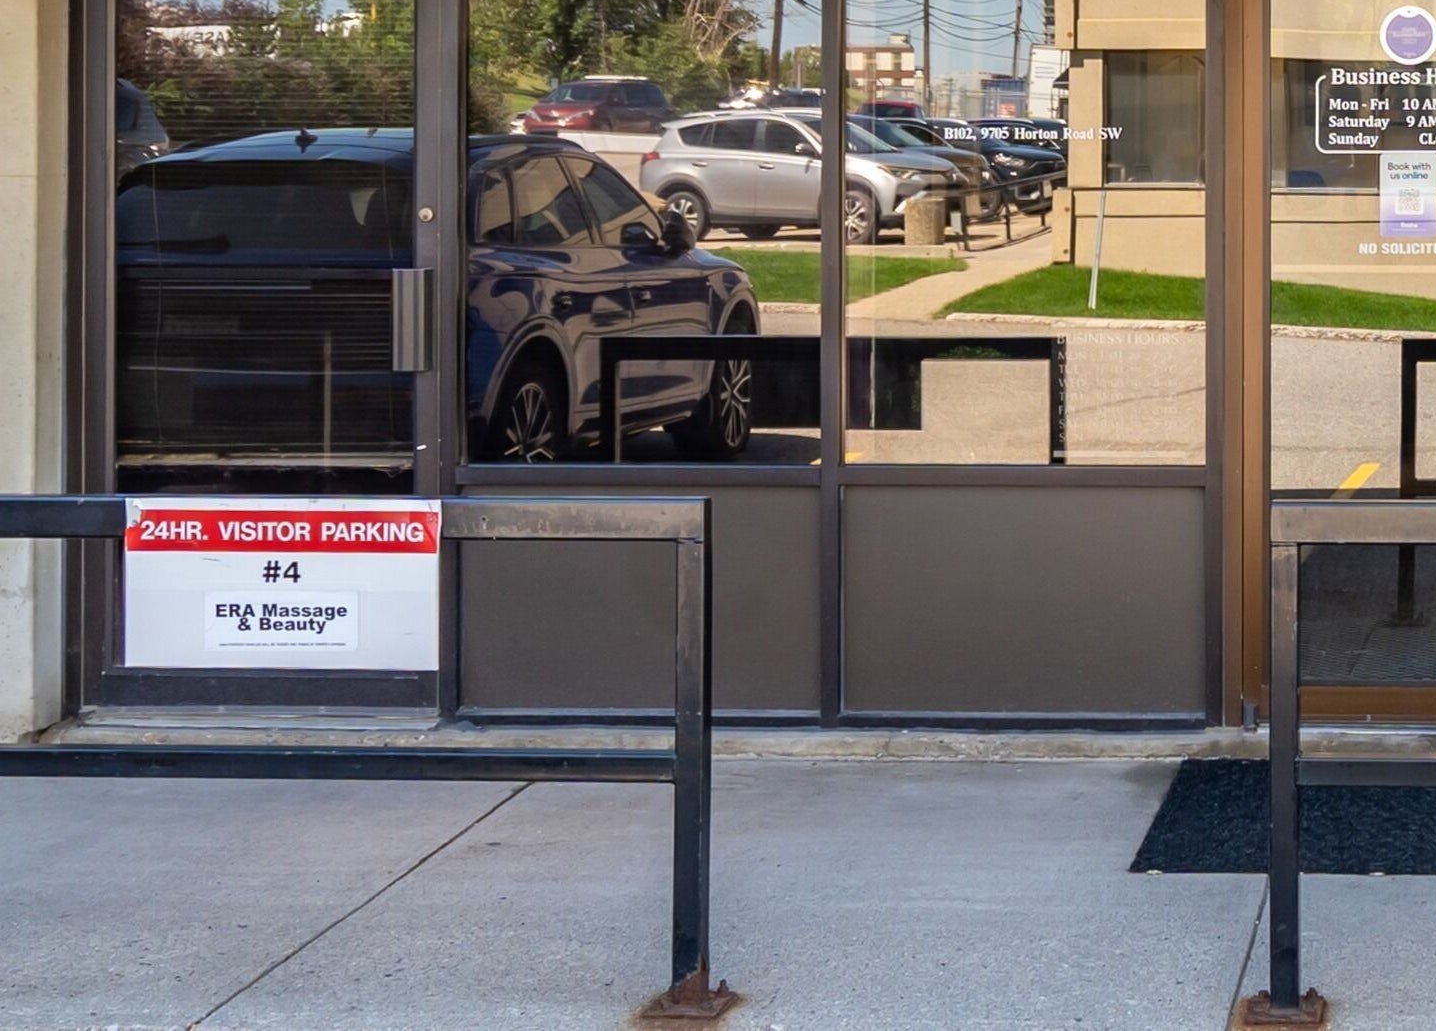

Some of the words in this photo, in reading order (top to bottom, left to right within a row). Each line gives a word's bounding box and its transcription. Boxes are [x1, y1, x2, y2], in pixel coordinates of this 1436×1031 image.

[1331, 68, 1420, 86] Business
[1329, 98, 1359, 111] Mon
[1370, 98, 1390, 111] Fri
[1402, 98, 1418, 111] 10
[1328, 115, 1390, 130] Saturday
[1406, 115, 1416, 128] 9
[944, 127, 977, 142] B102,
[981, 127, 1009, 140] 9705
[1014, 127, 1058, 140] Horton
[1063, 127, 1094, 140] Road
[1098, 127, 1122, 140] SW
[1328, 133, 1379, 148] Sunday
[1387, 161, 1409, 171] Book
[1411, 161, 1431, 171] with
[1390, 172, 1400, 181] us
[1402, 171, 1429, 181] online
[1359, 243, 1378, 255] NO
[140, 520, 209, 541] 24HR.
[218, 521, 311, 542] VISITOR
[321, 521, 425, 543] PARKING
[262, 561, 301, 583] #4
[216, 604, 256, 618] ERA
[262, 604, 348, 620] Massage
[237, 618, 252, 631] &
[259, 617, 326, 634] Beauty
